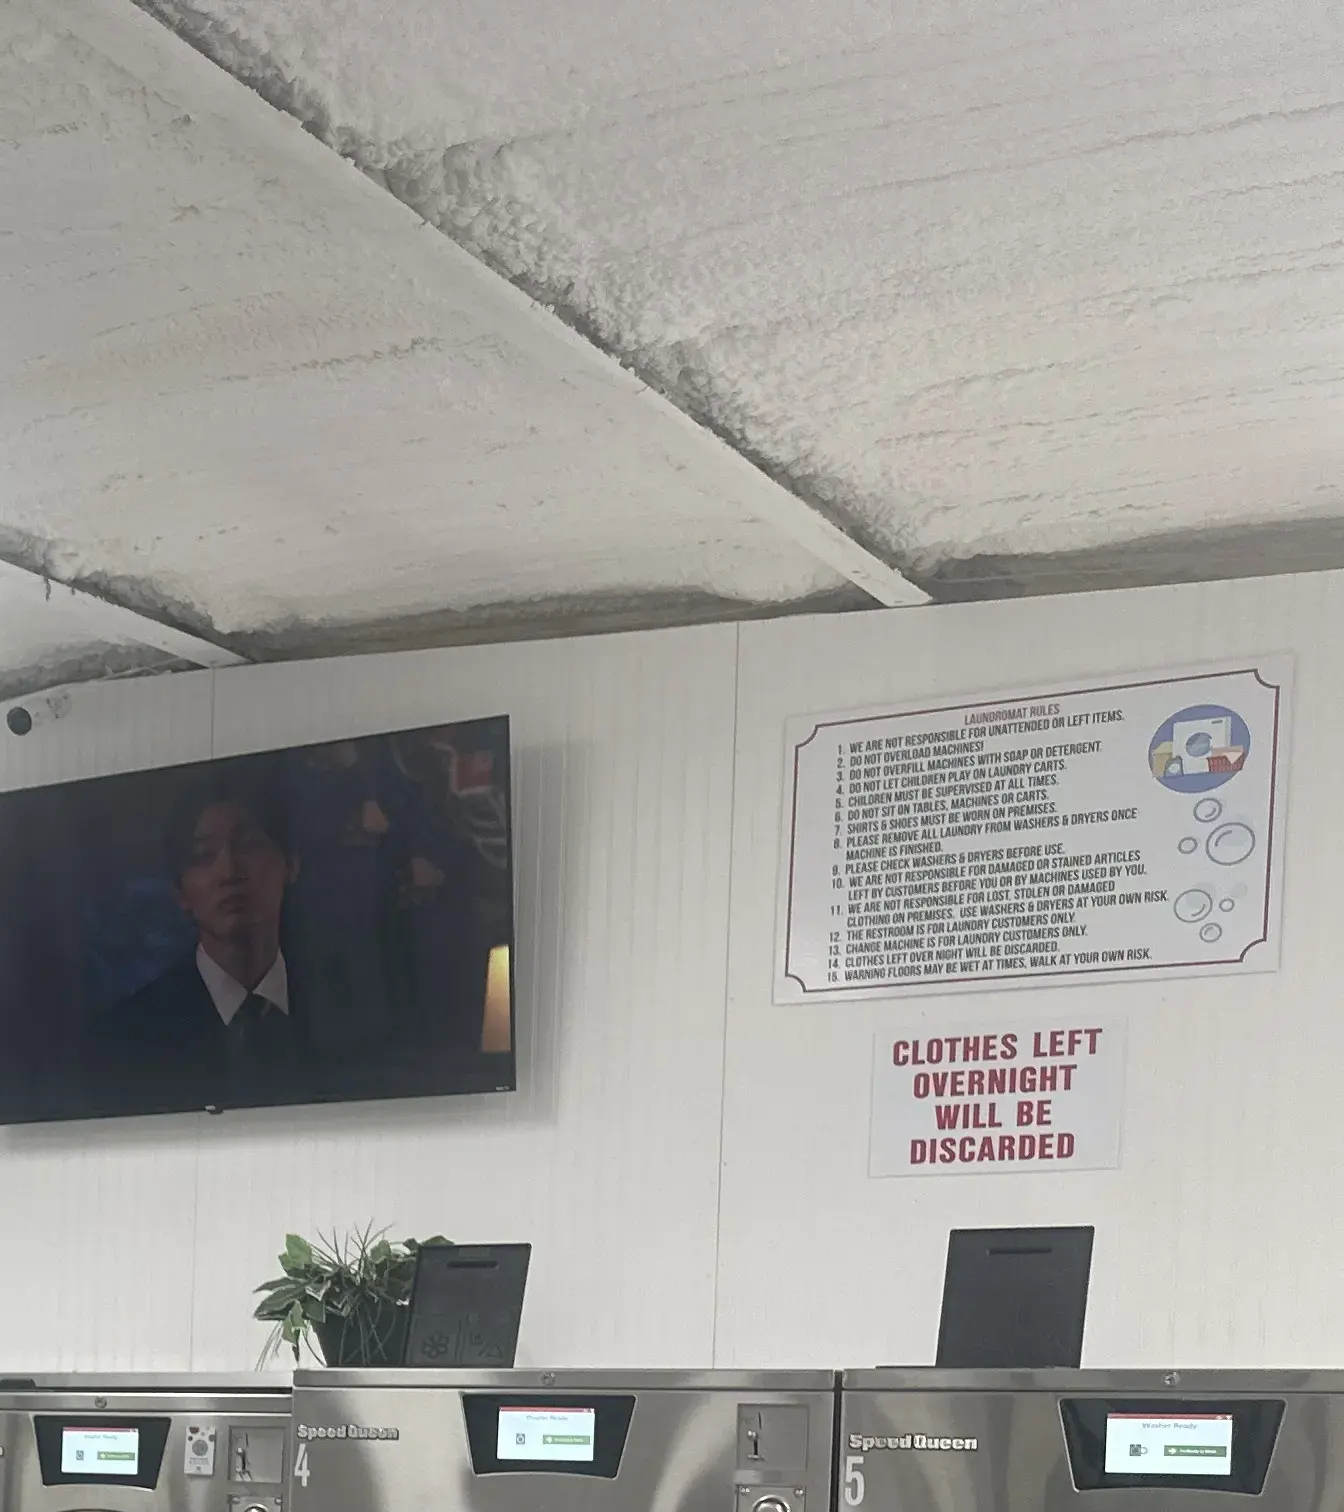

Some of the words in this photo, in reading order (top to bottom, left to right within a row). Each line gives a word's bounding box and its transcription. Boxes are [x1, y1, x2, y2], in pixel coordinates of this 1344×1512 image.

[963, 706, 1027, 725] LAUNDROMAT
[1028, 702, 1060, 718] RULES
[848, 740, 863, 753] WE
[864, 738, 883, 751] ARE
[884, 735, 903, 749] NOT
[904, 728, 966, 746] RESPONSIBLE
[967, 725, 987, 739] FOR
[987, 718, 1050, 737] UNATTENDED
[1066, 713, 1090, 727] LEFT
[862, 765, 881, 778] NOT
[882, 760, 925, 776] OVERFILL
[926, 754, 976, 771] MACHINES
[976, 751, 1002, 765] WITH
[1002, 748, 1029, 763] SOAP
[863, 752, 882, 765] NOT
[882, 746, 931, 763] OVERLOAD
[847, 791, 892, 807] CHILDREN
[893, 788, 919, 802] MUST
[934, 780, 992, 798] SUPERVISED
[993, 779, 1006, 792] AT
[1007, 777, 1025, 790] ALL
[862, 779, 881, 792] NOT
[882, 777, 899, 790] LET
[900, 771, 946, 788] CHILDREN
[947, 769, 971, 783] PLAY
[987, 762, 1032, 778] LAUNDRY
[846, 819, 879, 834] SHIRTS
[888, 815, 919, 830] SHOES
[919, 812, 946, 826] MUST
[961, 808, 991, 822] WORN
[860, 806, 879, 819] NOT
[880, 804, 895, 817] SIT
[950, 793, 999, 810] MACHINES
[845, 832, 879, 847] PLEASE
[880, 828, 919, 843] REMOVE
[920, 827, 938, 840] ALL
[939, 822, 983, 838] LAUNDRY
[983, 819, 1012, 833] FROM
[1012, 814, 1060, 831] WASHERS
[1070, 810, 1109, 825] DRYERS
[1110, 807, 1137, 821] ONCE
[844, 860, 878, 874] PLEASE
[879, 857, 910, 871] CHECK
[911, 852, 957, 868] WASHERS
[966, 848, 1004, 863] DRYERS
[845, 845, 887, 861] MACHINE
[848, 875, 863, 887] WE
[864, 873, 883, 886] ARE
[884, 871, 903, 884] NOT
[903, 865, 966, 882] RESPONSIBLE
[967, 863, 987, 876] FOR
[987, 859, 1035, 875] DAMAGED
[1050, 854, 1092, 869] STAINED
[1093, 849, 1141, 865] ARTICLES
[847, 887, 869, 900] LEFT
[884, 881, 940, 897] CUSTOMERS
[940, 878, 977, 892] BEFORE
[977, 876, 998, 889] YOU
[1028, 869, 1080, 885] MACHINES
[1080, 866, 1107, 880] USED
[847, 902, 862, 914] WE
[863, 900, 881, 913] ARE
[882, 898, 901, 911] NOT
[902, 893, 965, 909] RESPONSIBLE
[965, 891, 985, 904] FOR
[1013, 886, 1050, 900] STOLEN
[1066, 880, 1115, 896] DAMAGED
[846, 913, 891, 927] CLOTHING
[958, 905, 978, 918] USE
[978, 901, 1026, 917] WASHERS
[1035, 897, 1074, 912] DRYERS
[1075, 896, 1088, 909] AT
[1089, 894, 1117, 908] YOUR
[1117, 892, 1142, 906] OWN
[844, 940, 881, 954] CHANGE
[882, 937, 925, 951] MACHINE
[936, 935, 956, 947] FOR
[956, 931, 1001, 946] LAUNDRY
[1001, 927, 1060, 943] CUSTOMERS
[846, 928, 864, 941] THE
[864, 924, 914, 939] RESTROOM
[925, 922, 945, 935] FOR
[945, 918, 990, 933] LAUNDRY
[990, 914, 1049, 930] CUSTOMERS
[844, 953, 885, 967] CLOTHES
[885, 952, 908, 964] LEFT
[908, 950, 934, 963] OVER
[934, 947, 963, 961] NIGHT
[964, 946, 987, 959] WILL
[886, 964, 922, 978] FLOORS
[922, 963, 943, 975] MAY
[958, 960, 980, 973] WET
[981, 959, 994, 971] AT
[1028, 955, 1057, 968] WALK
[1058, 954, 1071, 966] AT
[1072, 952, 1099, 965] YOUR
[1100, 950, 1125, 963] OWN
[892, 1033, 1018, 1067] CLOTHES
[1033, 1028, 1103, 1058] LEFT
[913, 1064, 1078, 1099] OVERNIGHT
[934, 1102, 1002, 1131] WILL
[1016, 1100, 1052, 1127] BE
[910, 1133, 1075, 1165] DISCARDED
[297, 1424, 346, 1441] Speed
[348, 1424, 400, 1440] Queen
[848, 1433, 912, 1453] Speed
[913, 1433, 978, 1451] Queen
[294, 1443, 310, 1487] 4
[844, 1456, 865, 1506] 5
